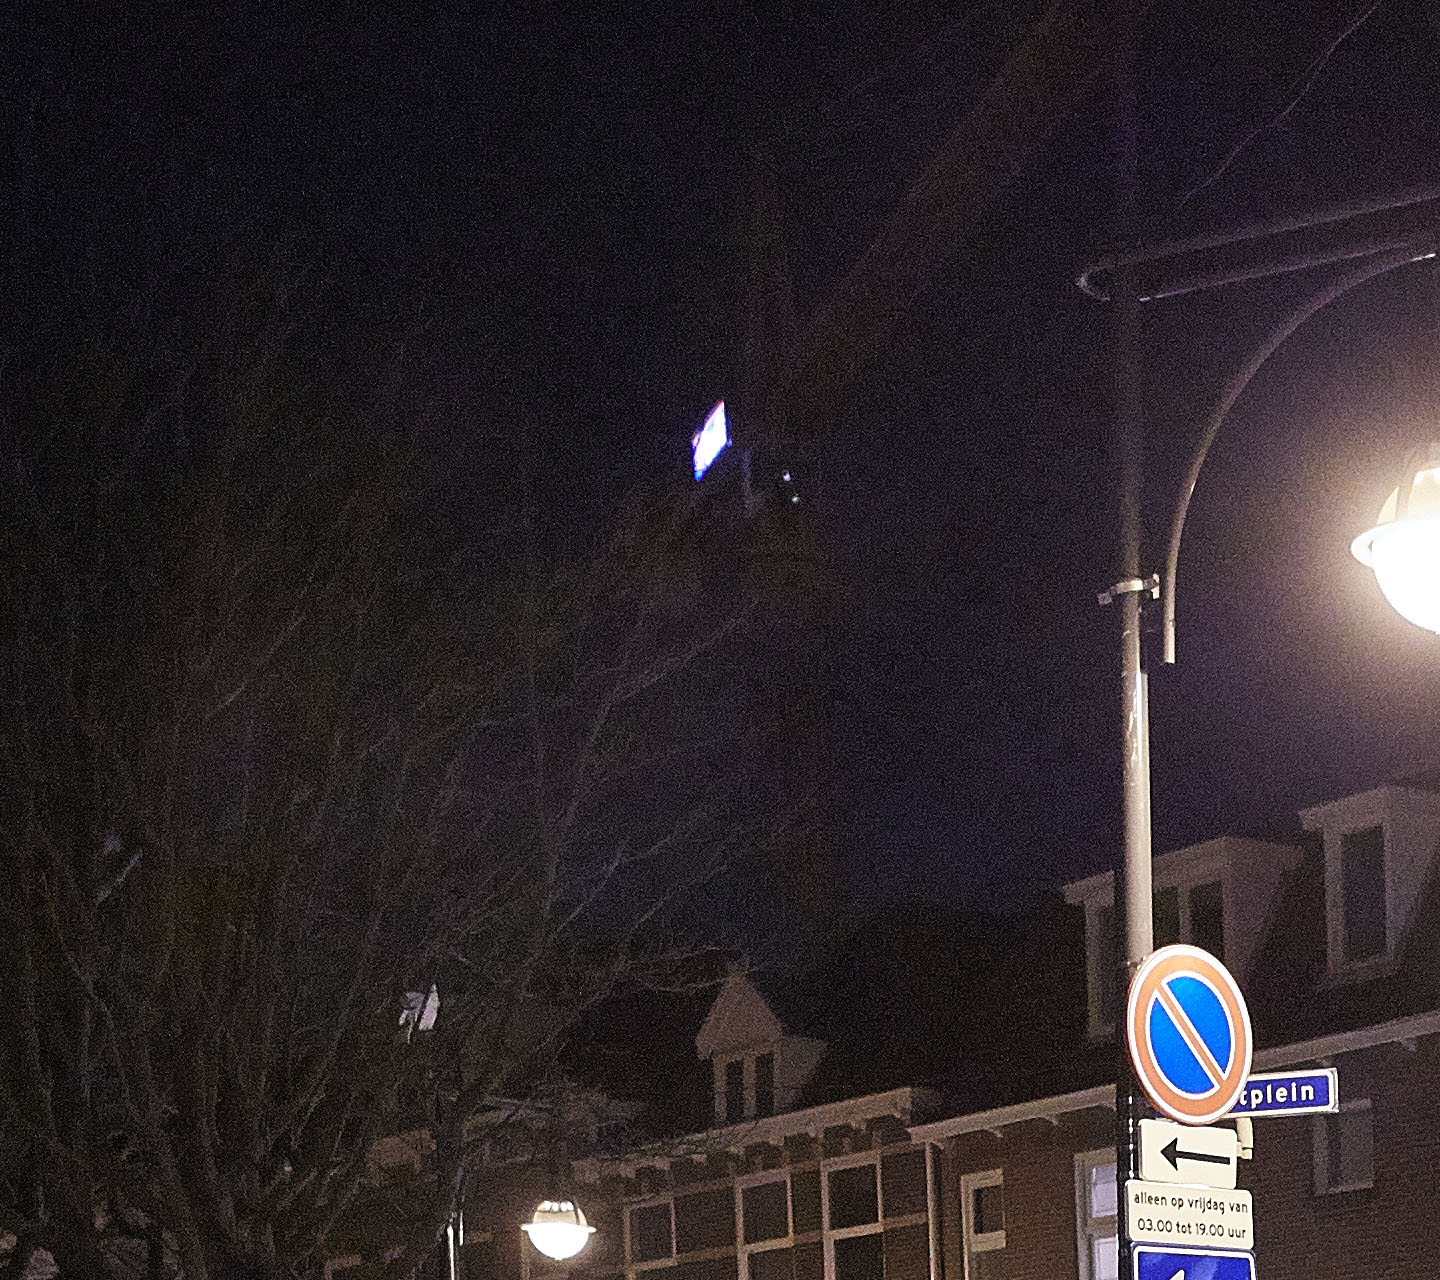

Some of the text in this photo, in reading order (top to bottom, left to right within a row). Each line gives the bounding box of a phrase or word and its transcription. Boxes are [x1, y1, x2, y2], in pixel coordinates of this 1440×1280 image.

[1133, 1192, 1249, 1214] alleen op vrijdag van
[1136, 1218, 1247, 1239] 03.00 tot 19.00 uur
